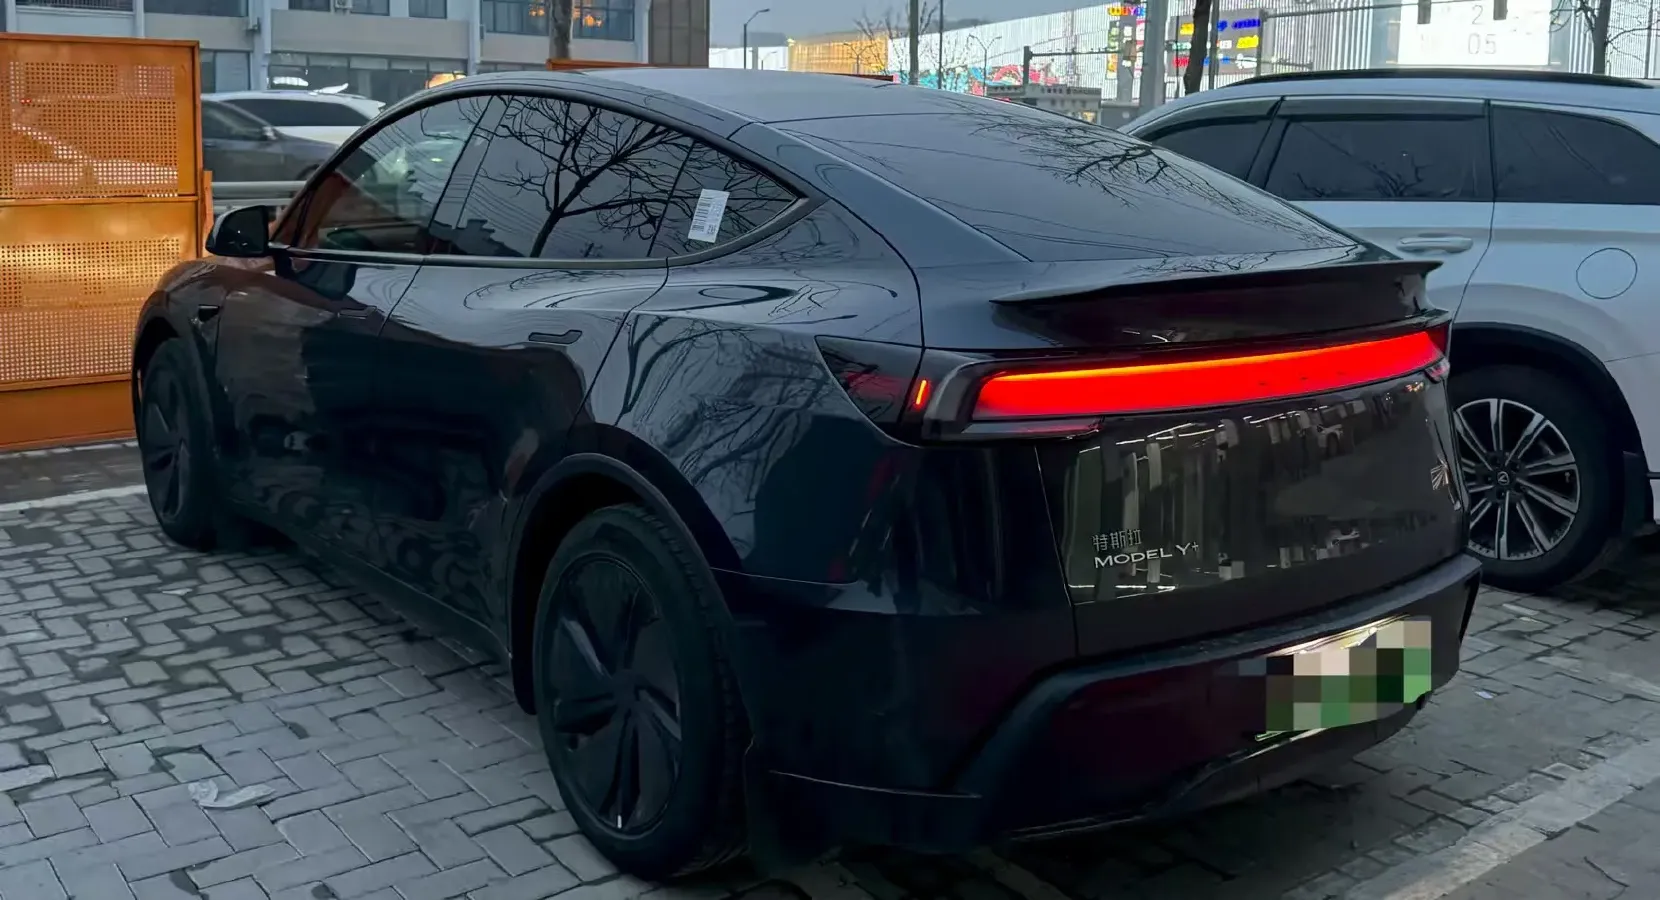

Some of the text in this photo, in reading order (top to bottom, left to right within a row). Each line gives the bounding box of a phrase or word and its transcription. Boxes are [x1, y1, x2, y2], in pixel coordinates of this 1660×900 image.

[1092, 529, 1142, 552] 特斯拉
[1094, 548, 1173, 568] MODEL
